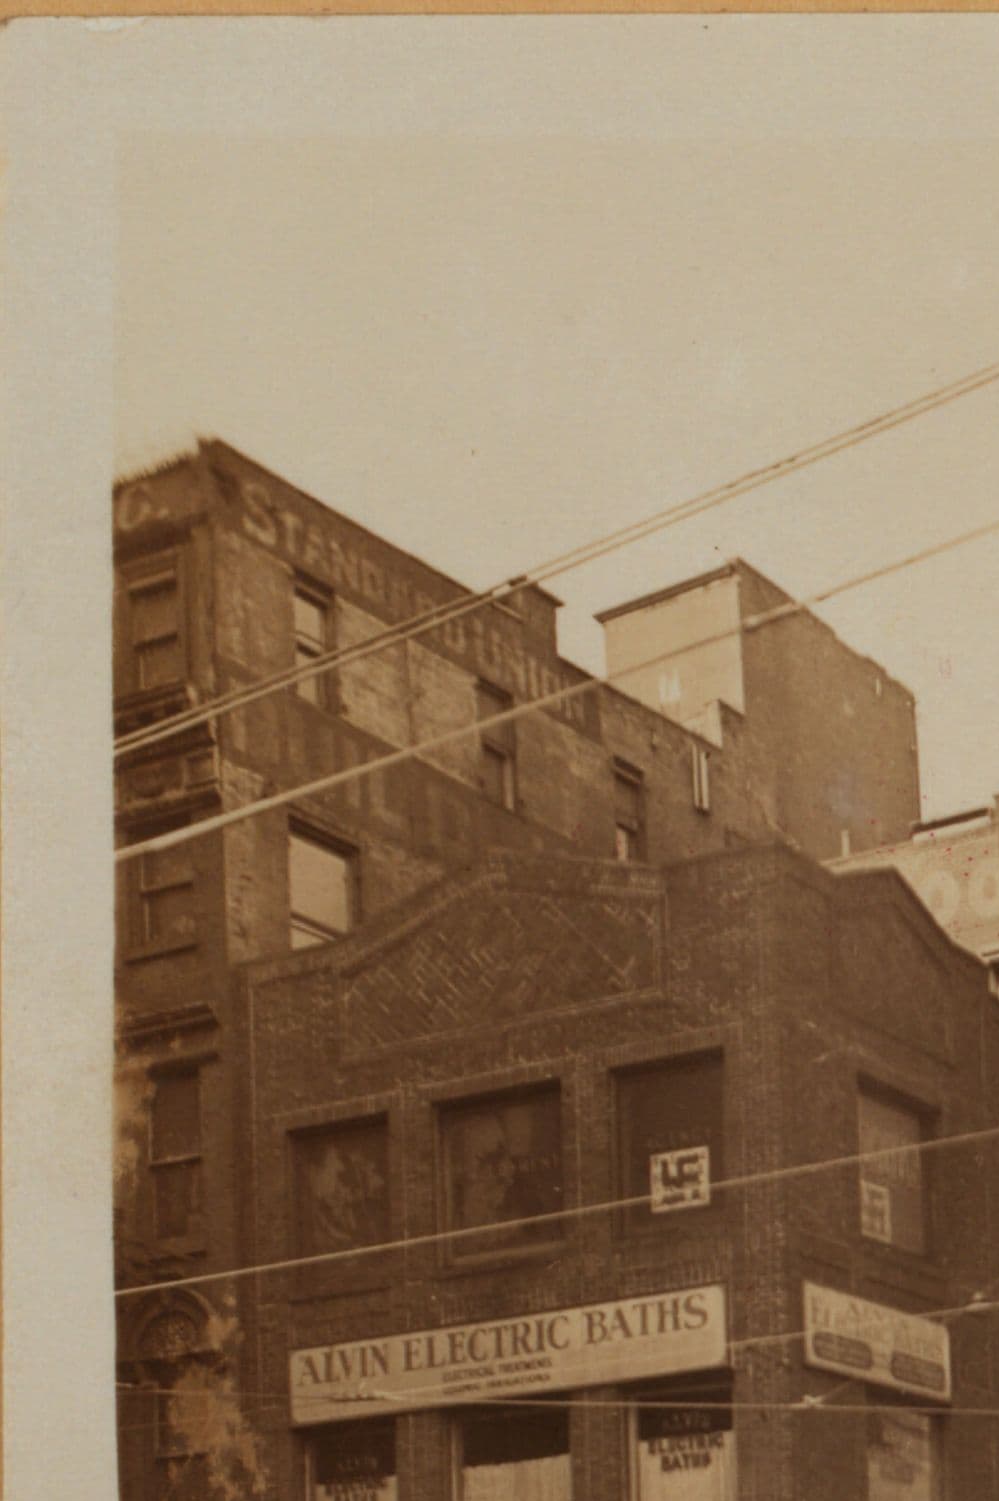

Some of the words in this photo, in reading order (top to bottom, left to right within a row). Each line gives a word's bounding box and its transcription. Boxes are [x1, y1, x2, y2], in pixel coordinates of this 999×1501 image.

[298, 1342, 391, 1386] ALVIN
[402, 1314, 571, 1372] ELECTRIC
[584, 1293, 709, 1345] BATHS
